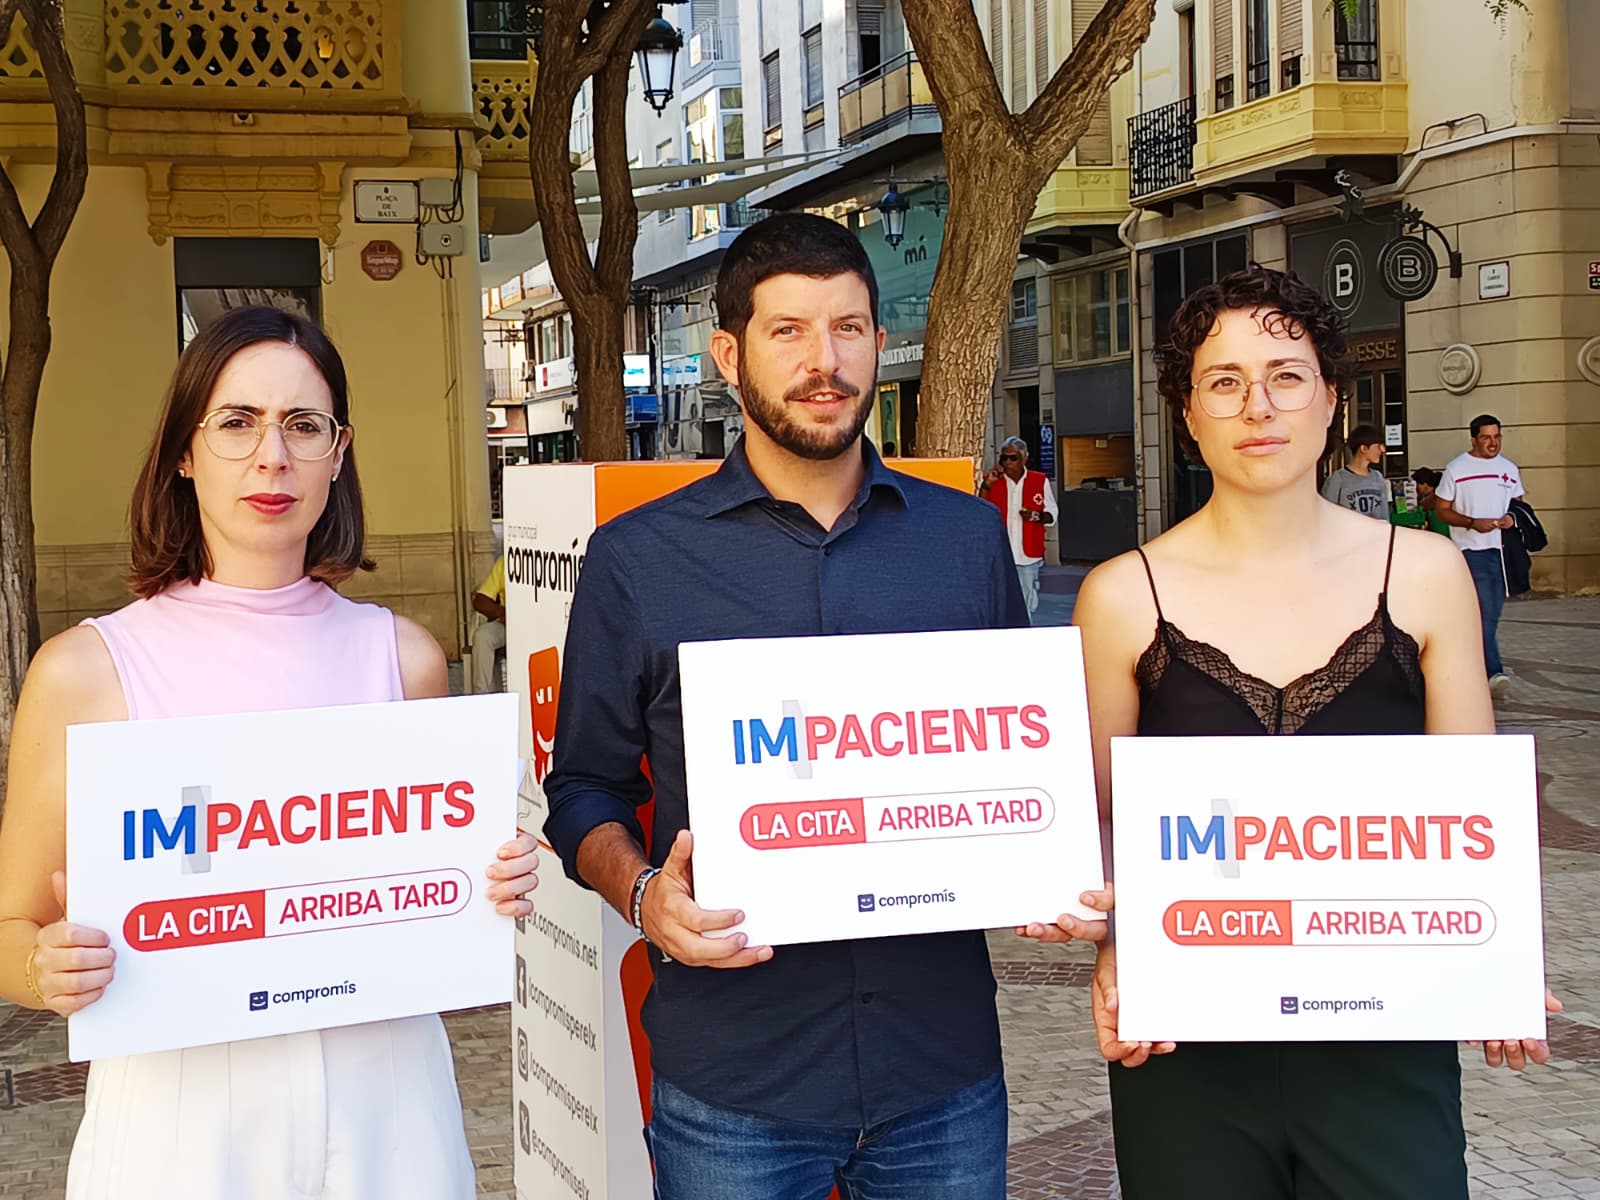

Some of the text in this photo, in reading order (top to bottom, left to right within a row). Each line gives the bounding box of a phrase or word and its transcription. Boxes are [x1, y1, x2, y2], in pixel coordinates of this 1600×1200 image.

[1335, 263, 1354, 297] B
[1397, 254, 1422, 282] B
[733, 704, 1049, 765] IMPACIENTS
[123, 781, 475, 861] IMPACIENTS
[751, 798, 1042, 841] LA CITA ARRIBA TARD
[1161, 815, 1495, 861] IMPACIENTS
[138, 880, 459, 941] LA CITA ARRIBA TARD
[879, 889, 956, 909] compromís
[1175, 909, 1483, 936] LA CITA ARRIBA TARD
[272, 980, 356, 1004] compromís
[1302, 996, 1384, 1014] compromís
